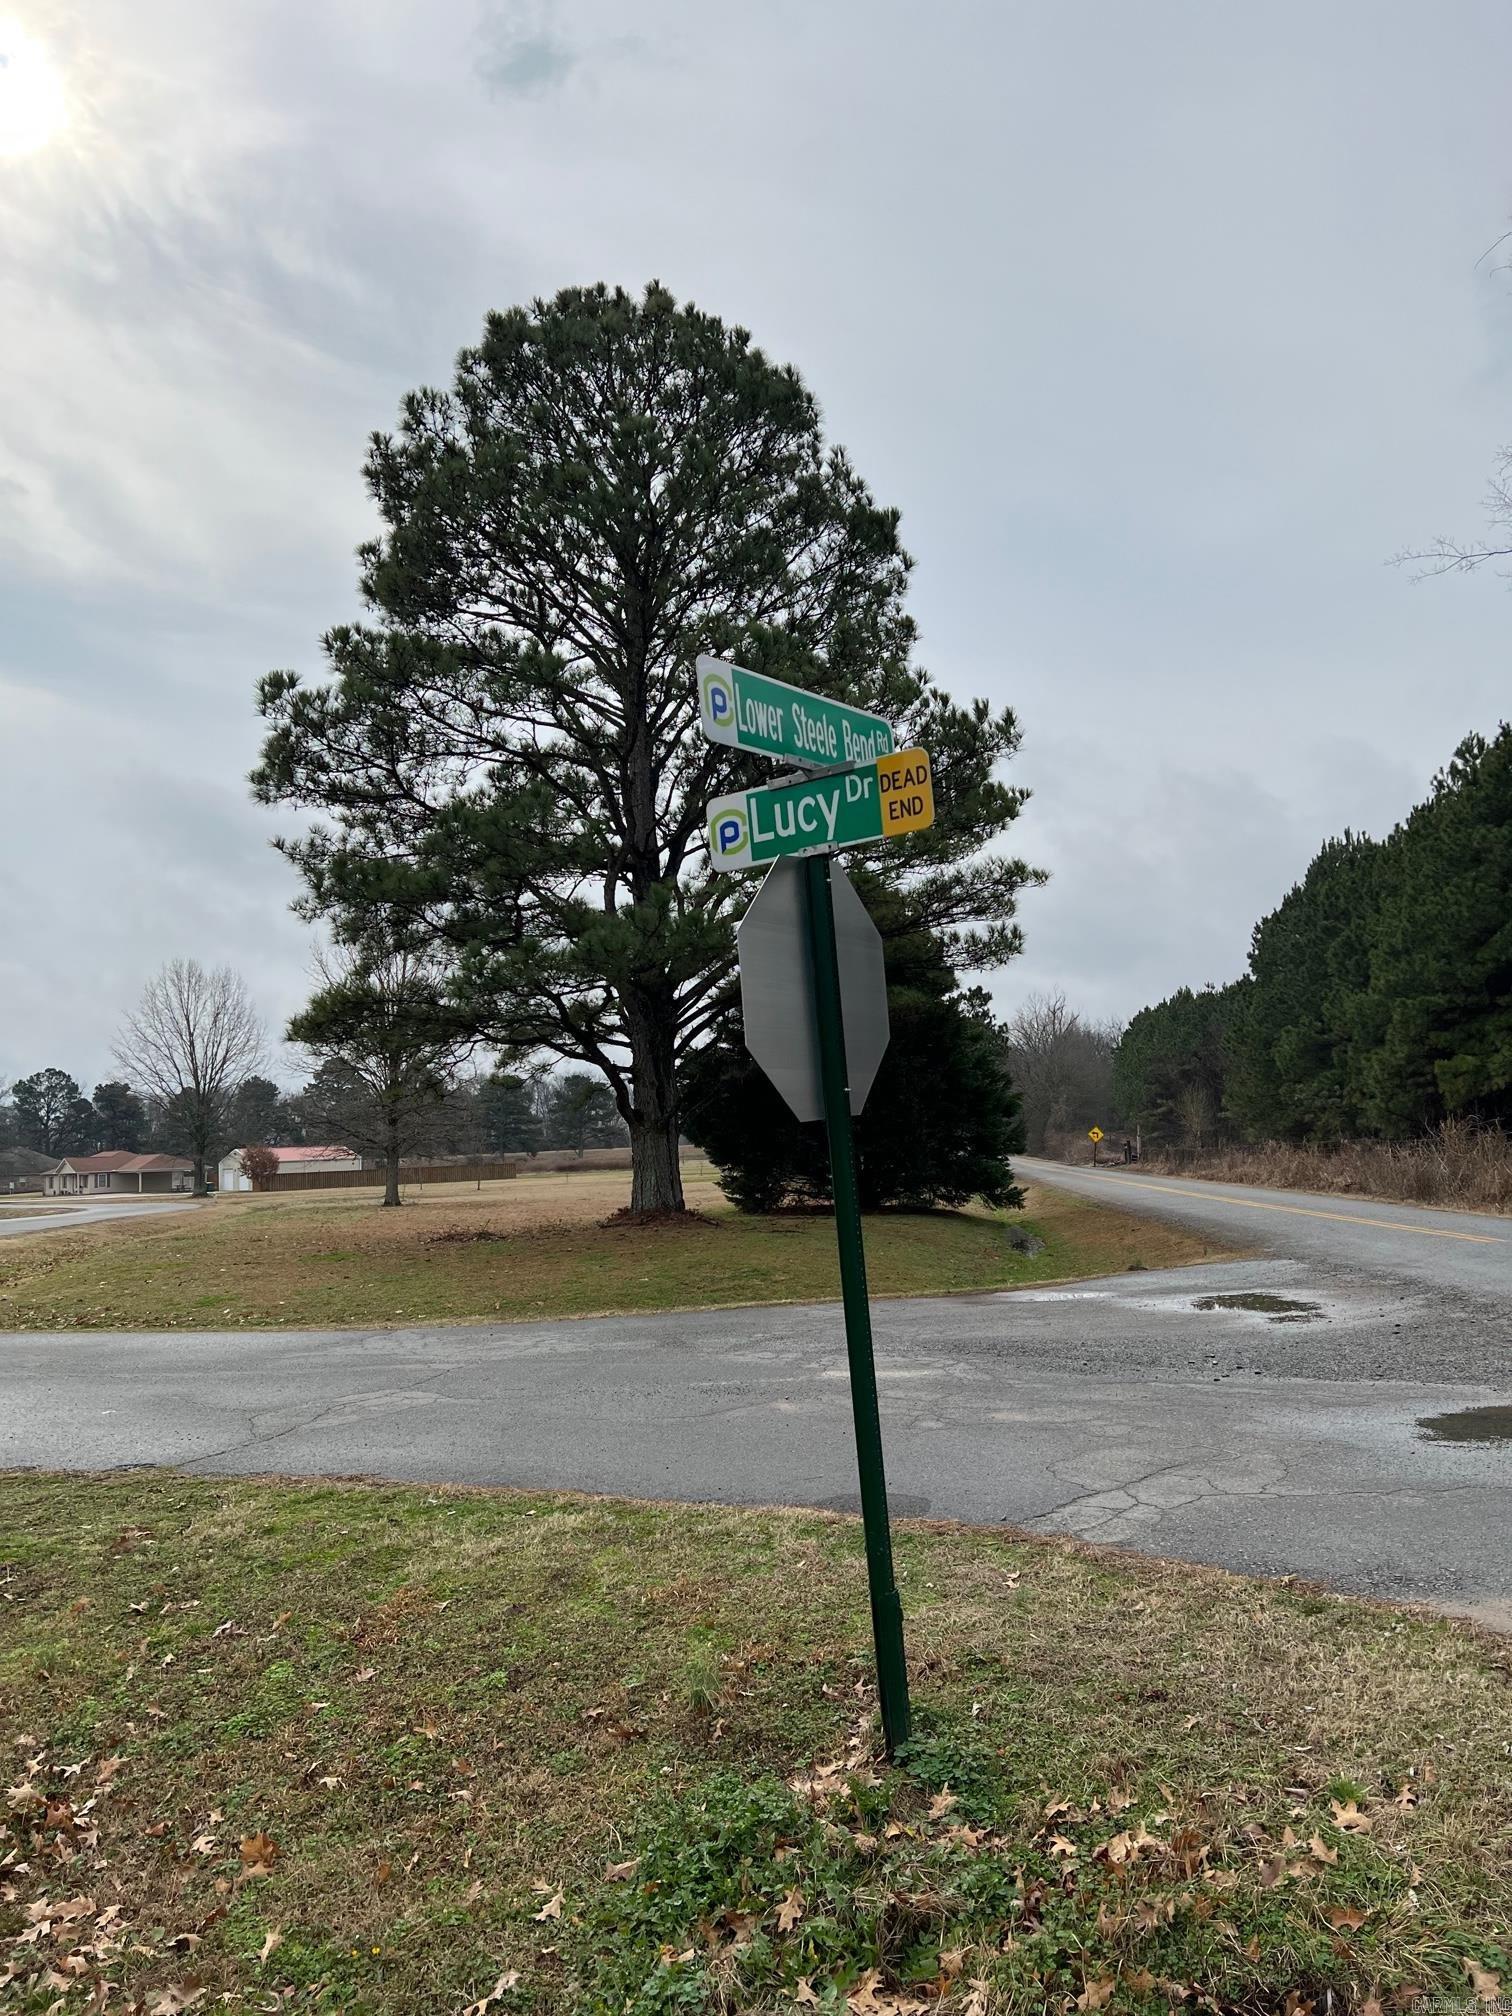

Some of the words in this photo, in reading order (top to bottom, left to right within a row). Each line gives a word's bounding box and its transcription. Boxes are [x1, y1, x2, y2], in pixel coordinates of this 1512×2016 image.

[734, 683, 784, 743] Lower
[791, 702, 838, 759] Steele
[842, 719, 876, 763] Bend
[876, 730, 889, 754] Rd
[880, 765, 928, 793] DEAD
[750, 789, 840, 843] Lucy
[845, 775, 874, 803] Dr
[889, 796, 924, 821] END
